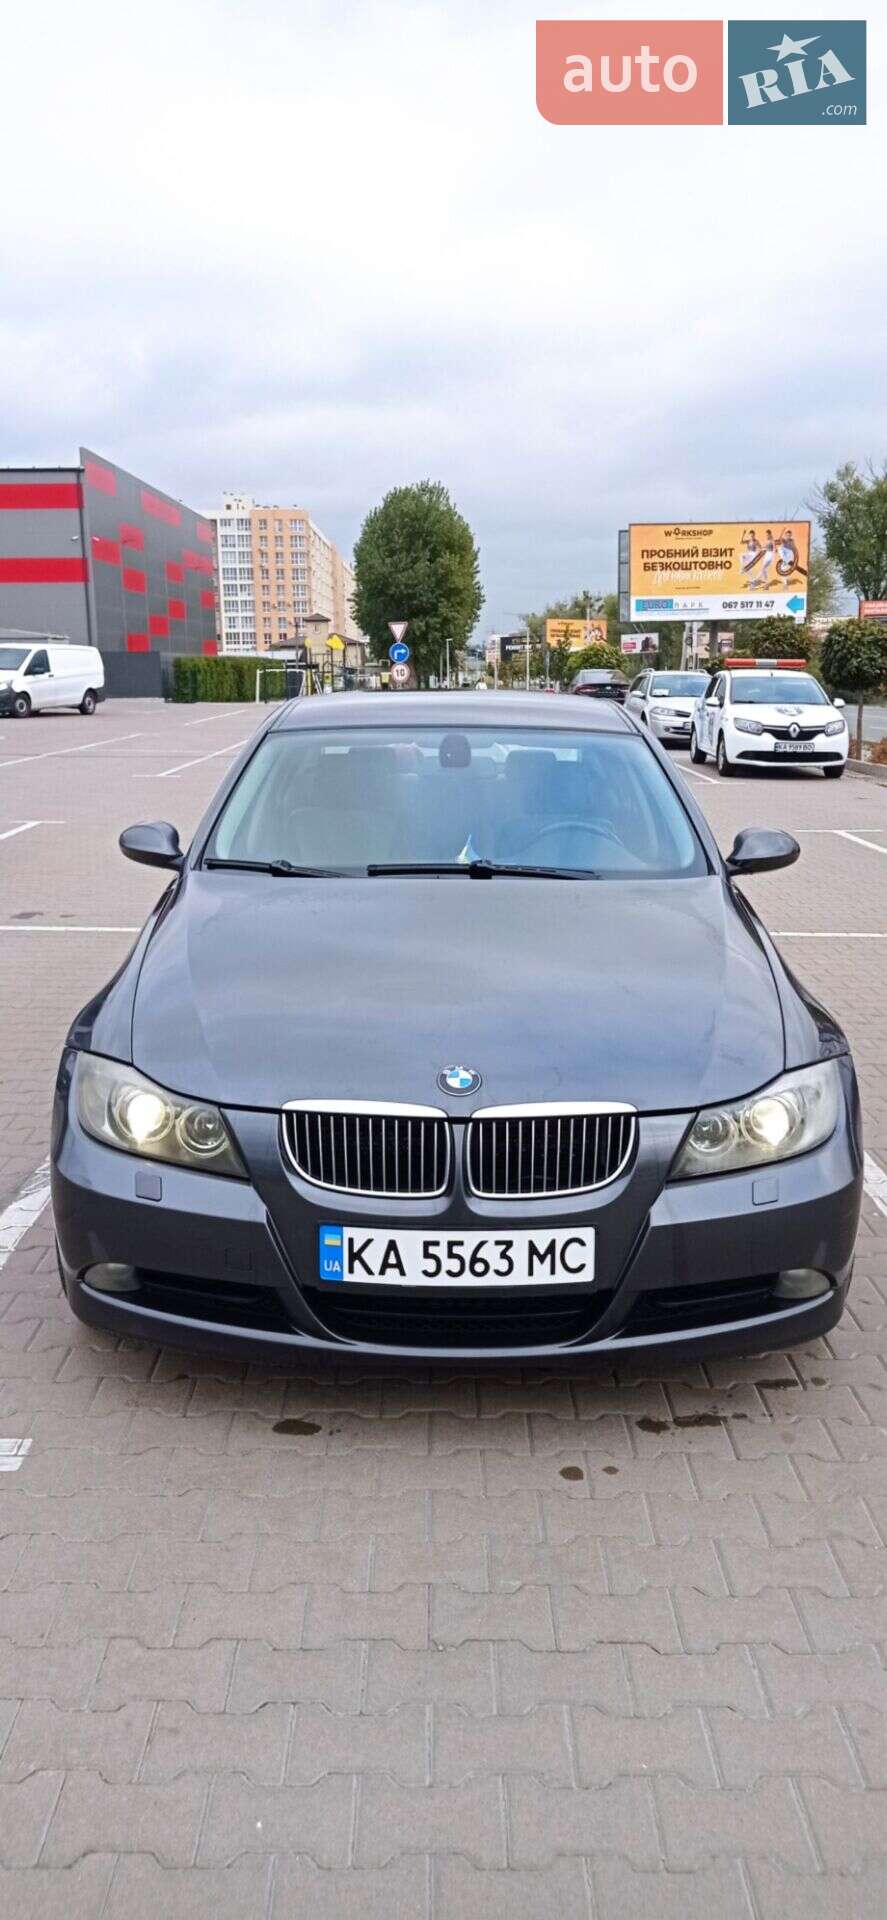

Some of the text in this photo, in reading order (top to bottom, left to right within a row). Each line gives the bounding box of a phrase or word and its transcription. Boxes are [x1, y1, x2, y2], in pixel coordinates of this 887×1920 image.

[641, 546, 735, 559] ПРОБНИЙ ВІЗИТ
[643, 561, 733, 572] БЕЗКОШТОВНО
[722, 600, 775, 609] 067 517 11 47
[396, 668, 405, 677] 10
[347, 1237, 587, 1278] KA 5563 MC
[324, 1261, 341, 1273] UA
